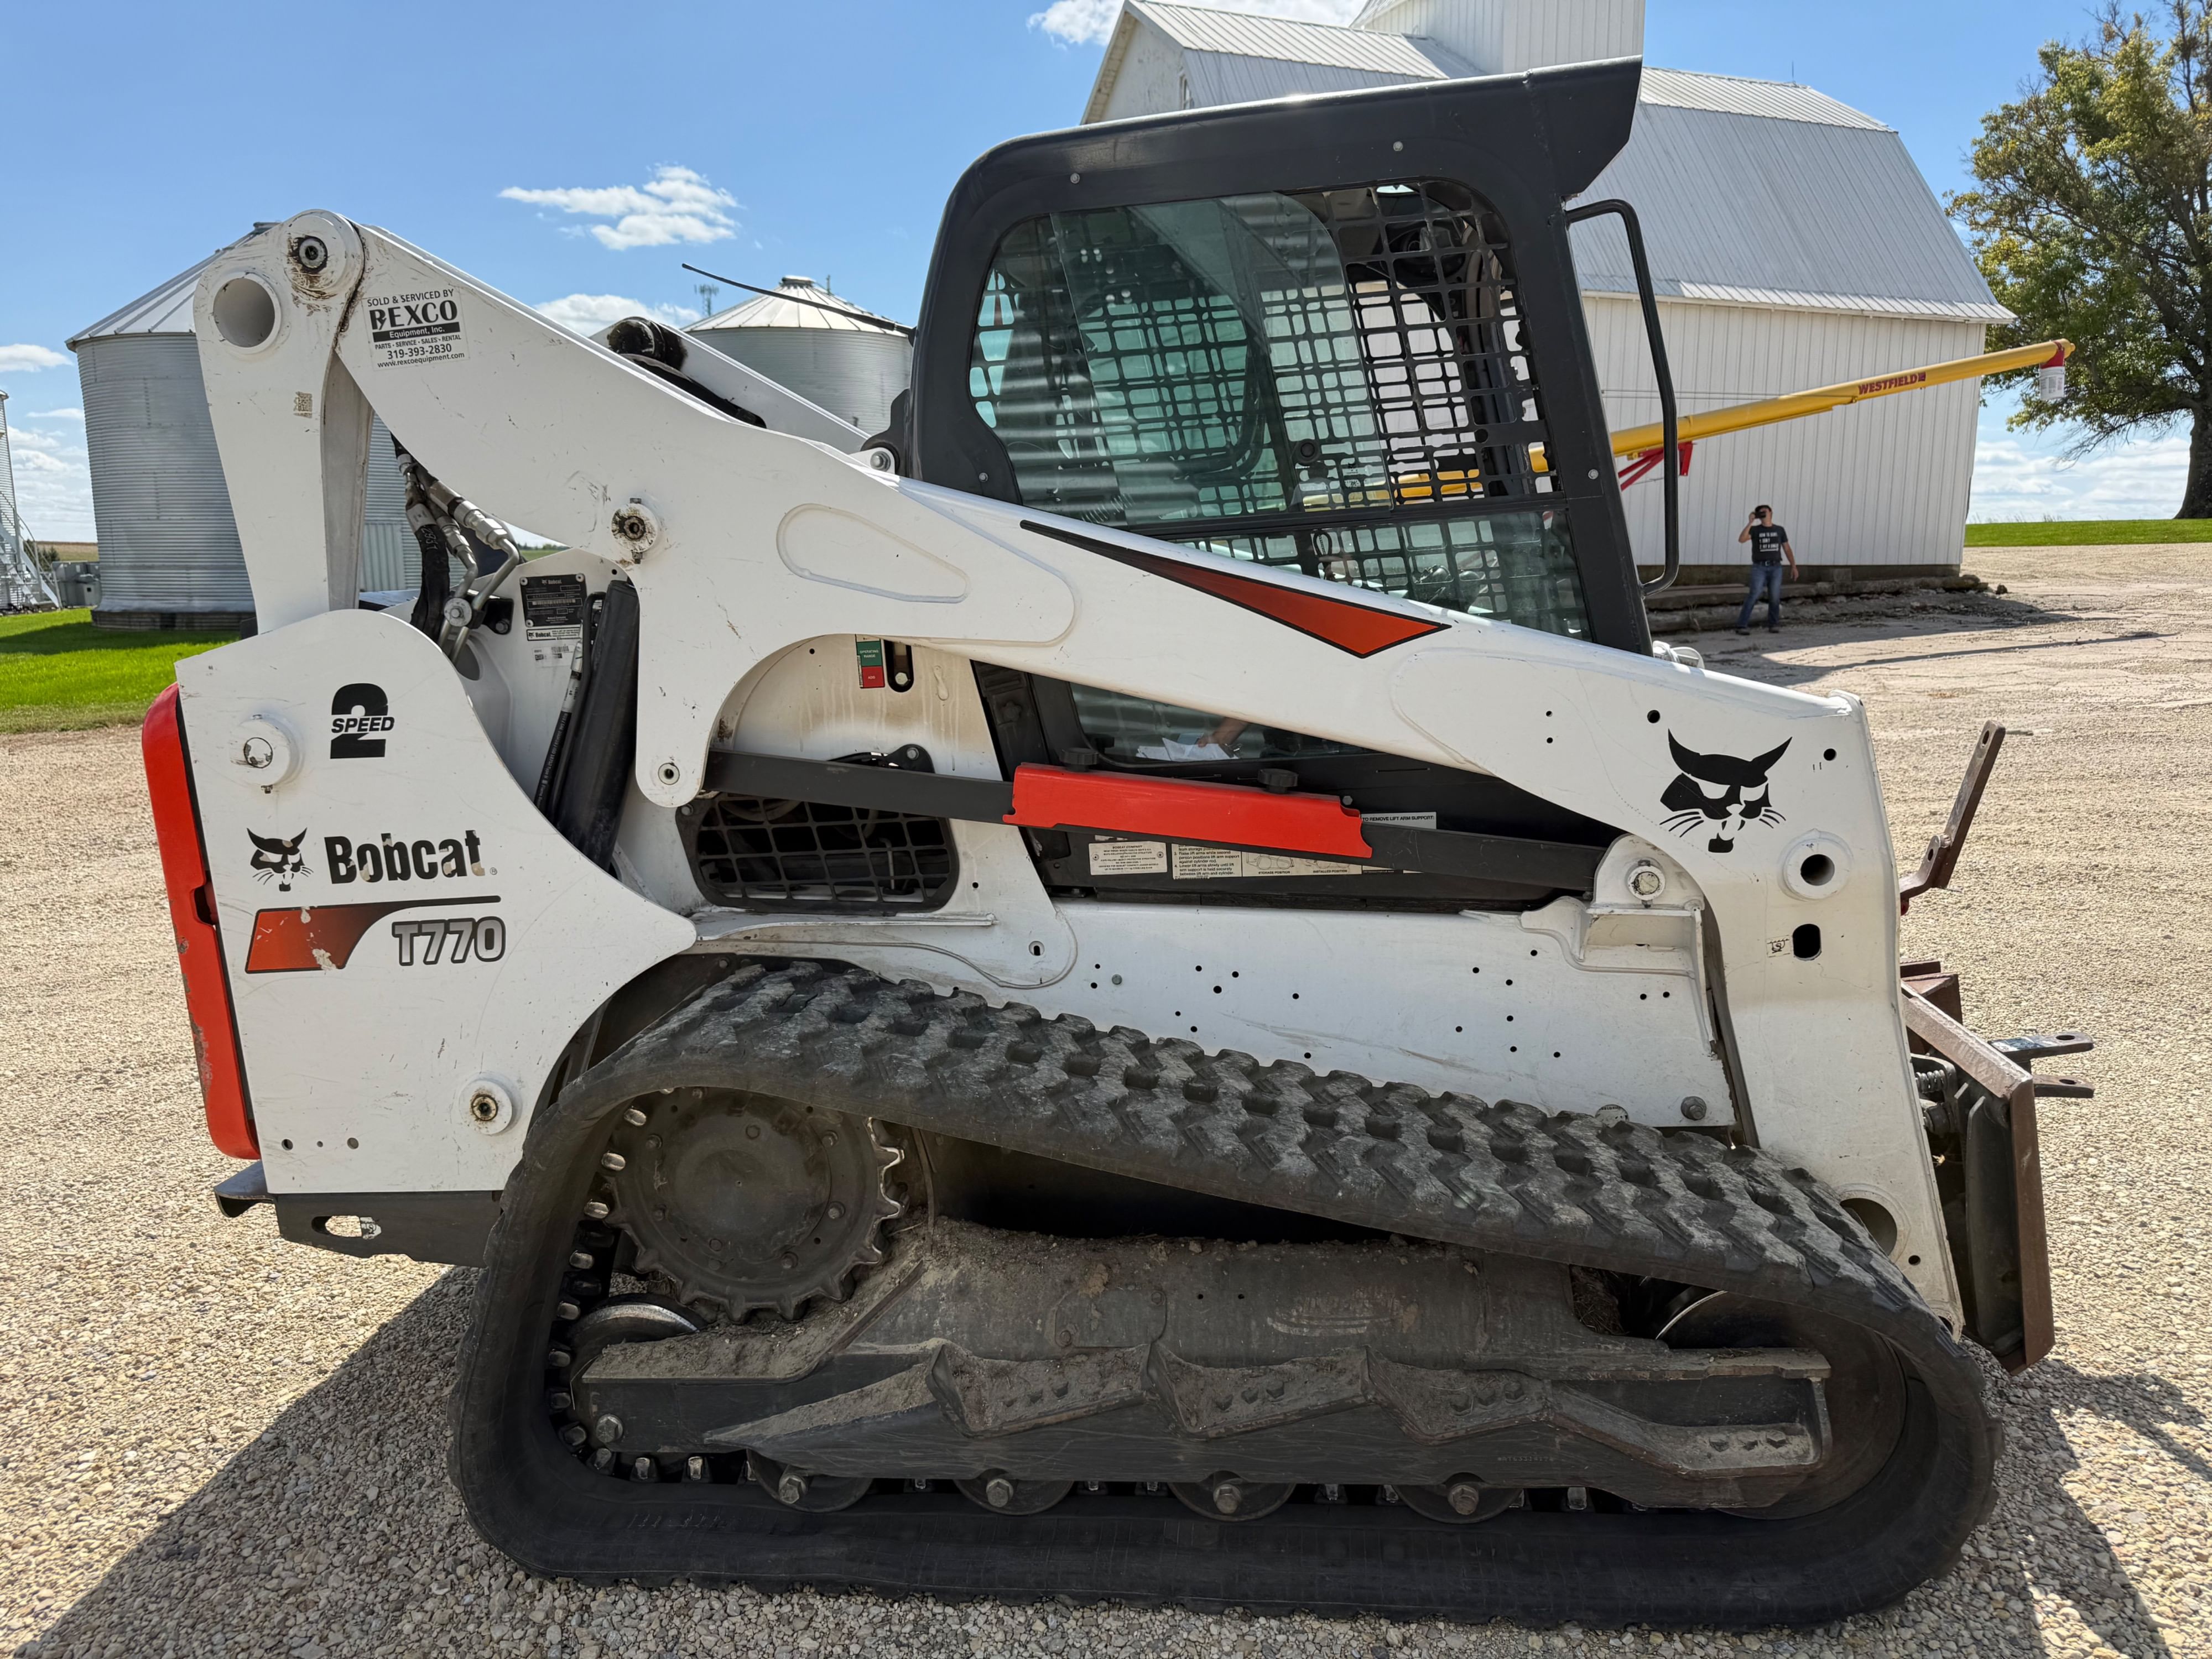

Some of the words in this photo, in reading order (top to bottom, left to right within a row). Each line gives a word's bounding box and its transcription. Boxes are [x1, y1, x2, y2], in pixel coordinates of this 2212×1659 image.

[367, 297, 389, 307] SOLD
[400, 290, 440, 303] SERVICED
[443, 289, 454, 297] BY
[369, 300, 458, 330] REXCO
[389, 327, 430, 339] Equipment,
[377, 352, 465, 368] www.rexcoequipment.com
[387, 343, 452, 359] 319-393-2830
[1859, 373, 1918, 395] WESTFIELD
[330, 683, 389, 759] 2
[331, 717, 395, 733] SPEED
[324, 830, 486, 884] Bobcat
[392, 916, 506, 966] T770
